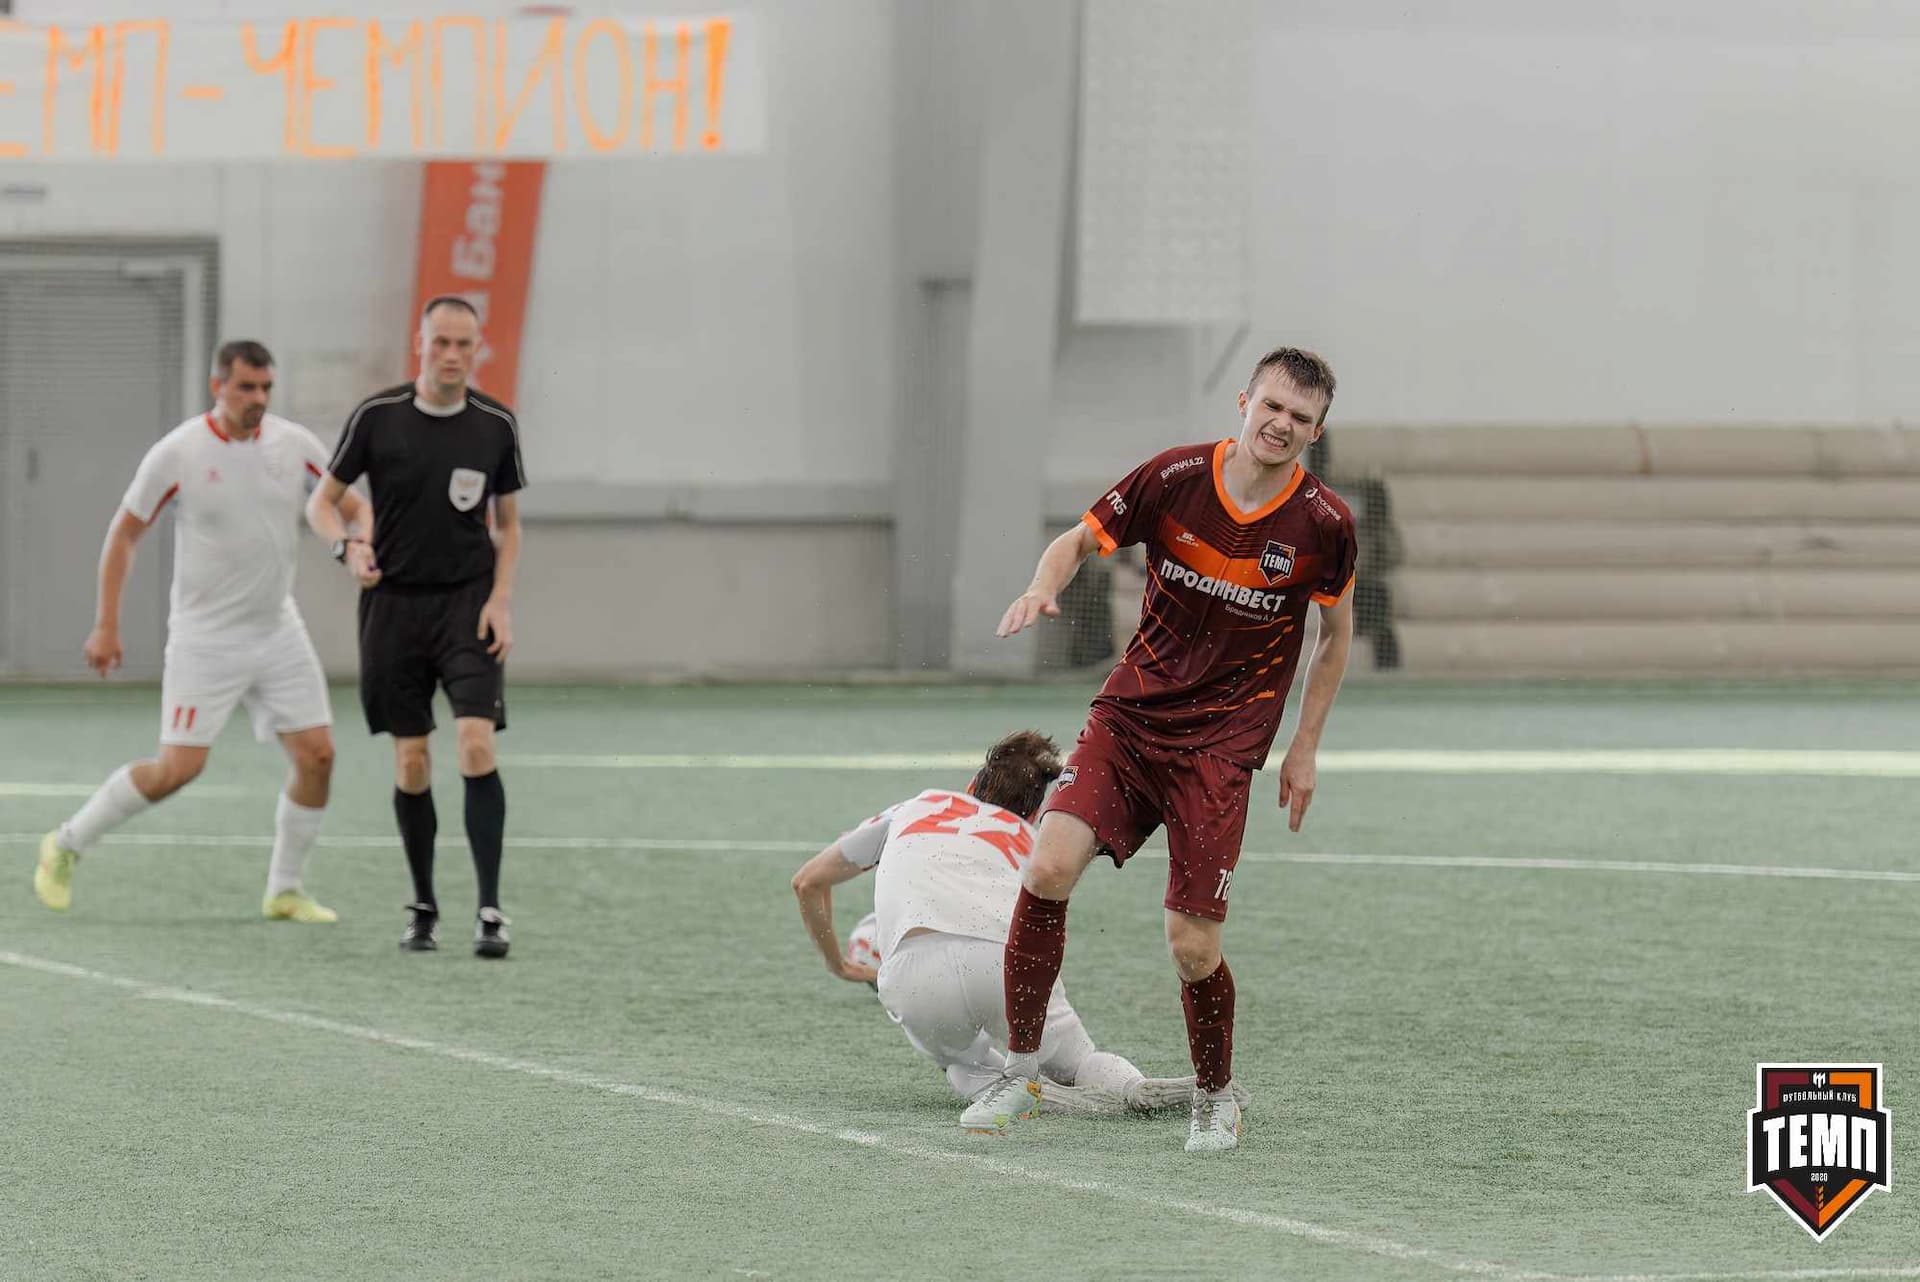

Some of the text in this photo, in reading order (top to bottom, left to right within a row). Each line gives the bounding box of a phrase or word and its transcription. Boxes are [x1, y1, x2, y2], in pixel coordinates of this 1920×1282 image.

[1264, 553, 1292, 574] ТЕМП
[1160, 558, 1286, 612] ПРОДИНВЕСТ
[173, 706, 197, 731] 11
[896, 794, 1034, 872] 22
